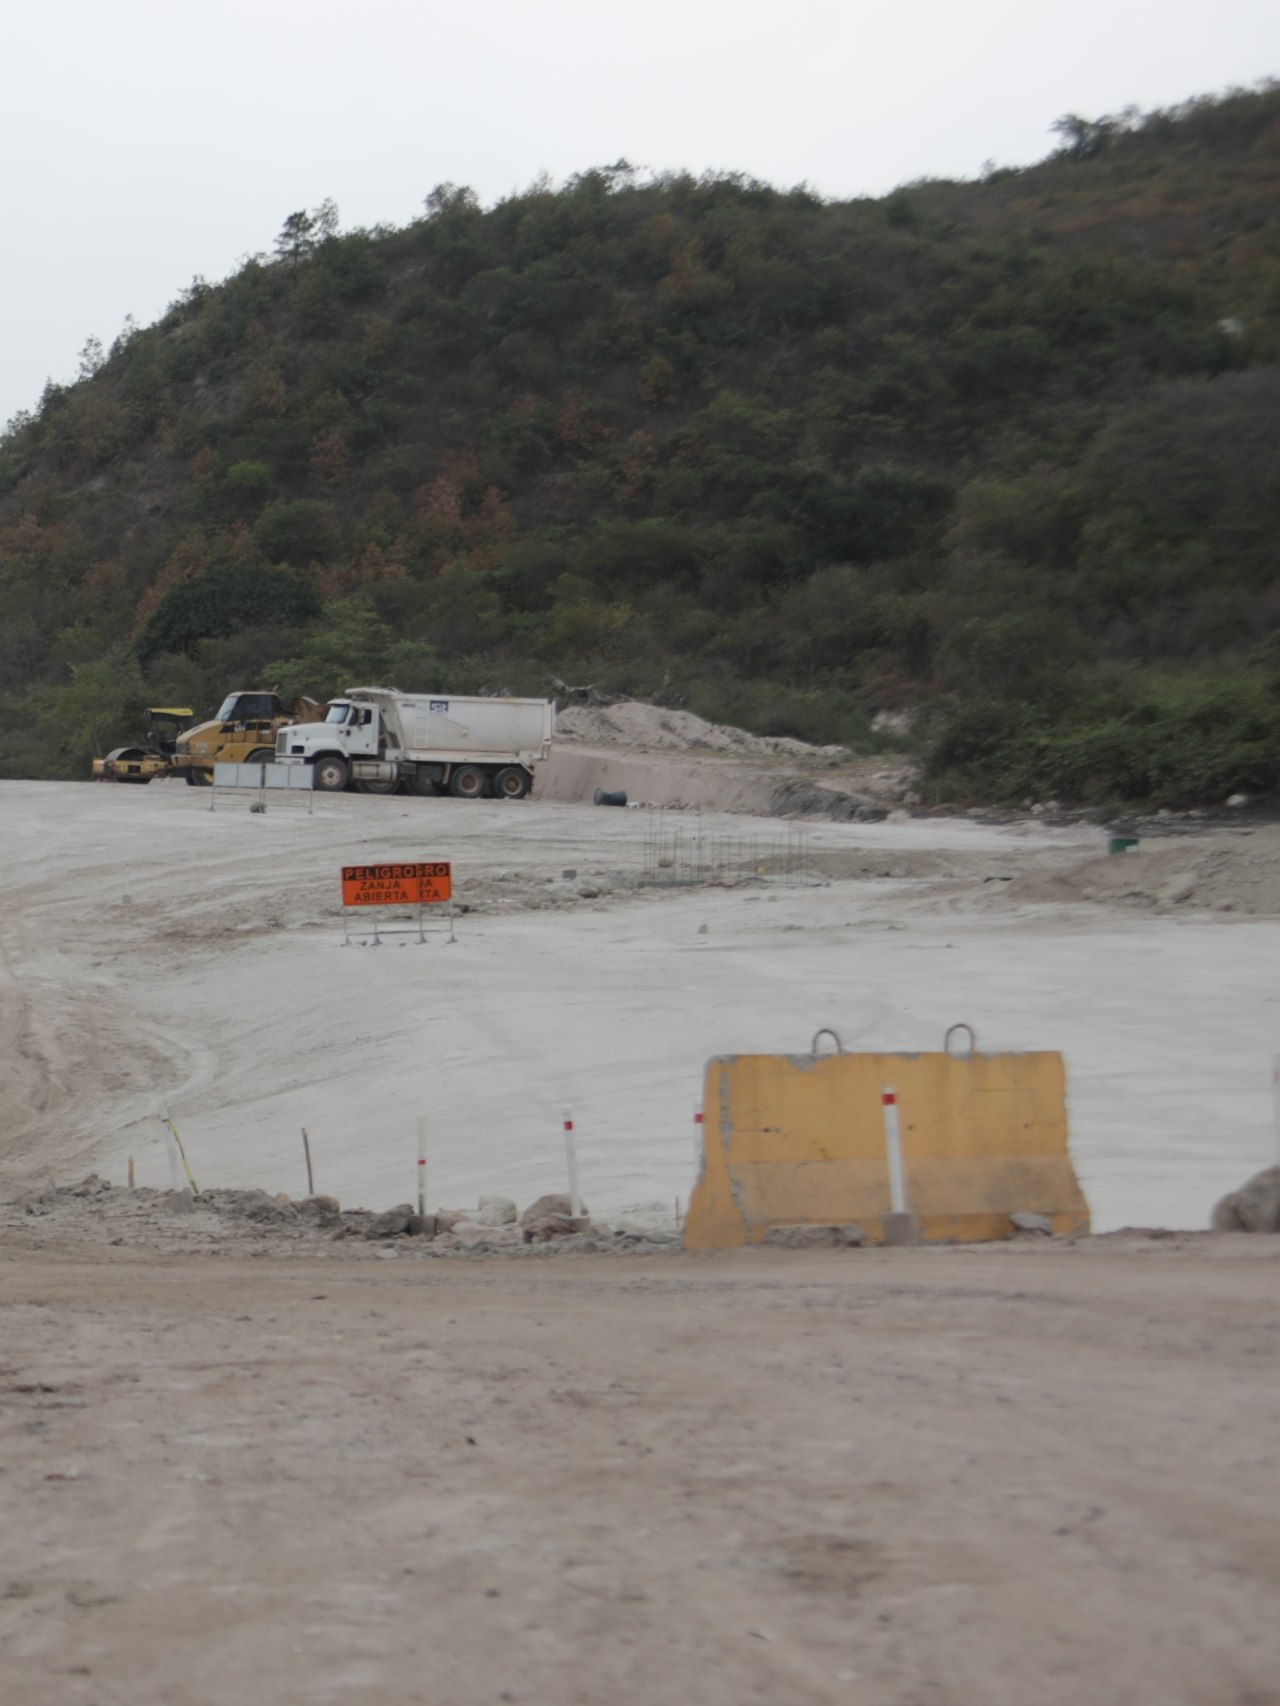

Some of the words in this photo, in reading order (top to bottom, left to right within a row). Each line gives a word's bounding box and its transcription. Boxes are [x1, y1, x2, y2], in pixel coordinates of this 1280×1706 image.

[345, 866, 414, 880] PELIGRO
[360, 880, 401, 891] ZANJA
[354, 891, 409, 902] ABIERTA
